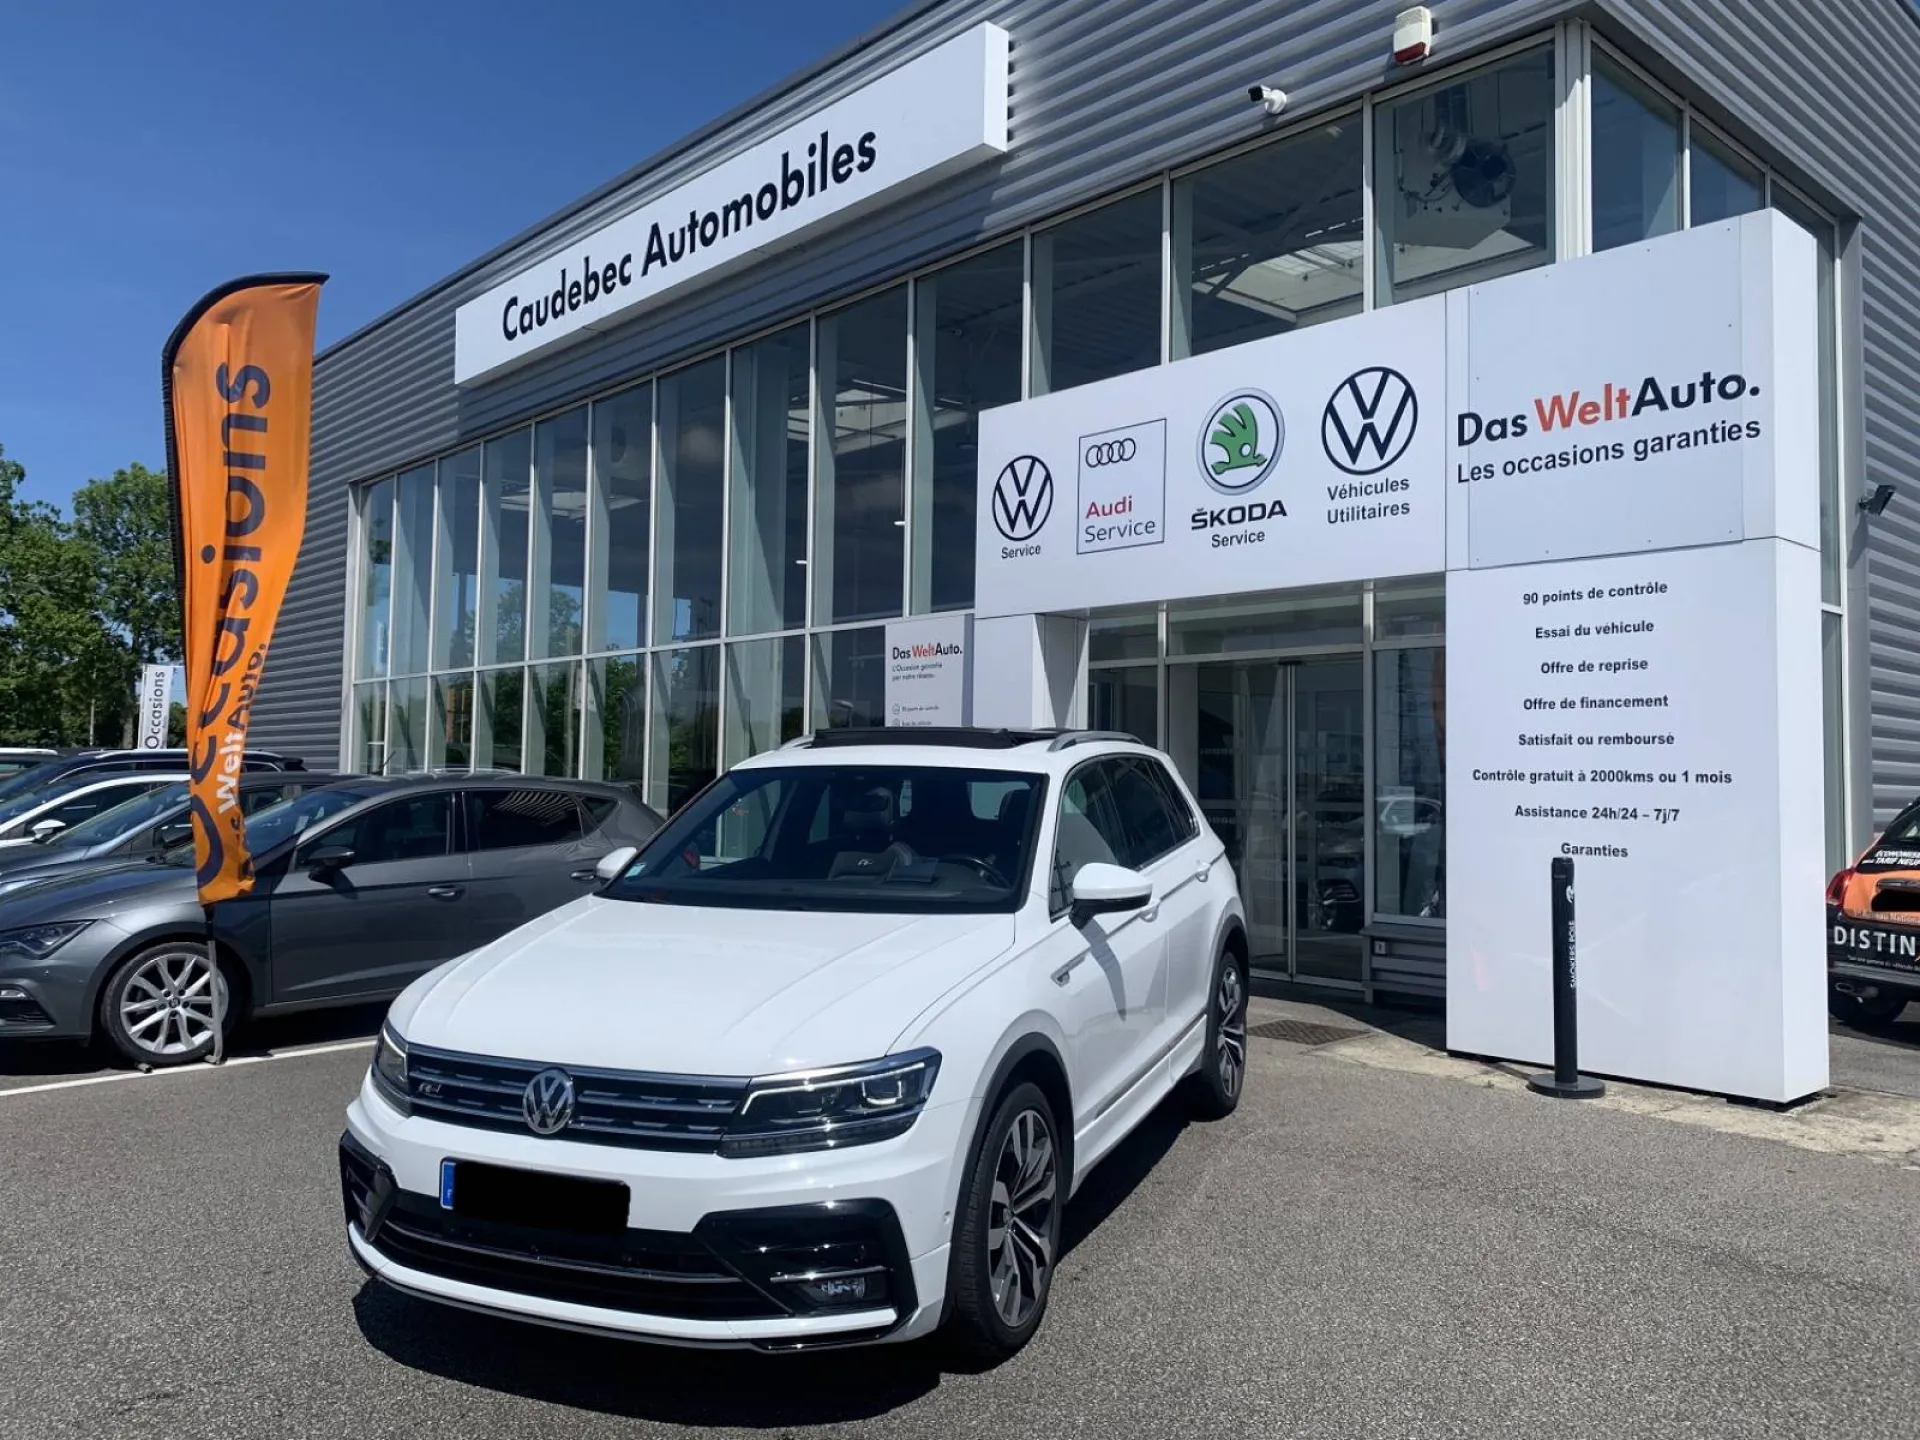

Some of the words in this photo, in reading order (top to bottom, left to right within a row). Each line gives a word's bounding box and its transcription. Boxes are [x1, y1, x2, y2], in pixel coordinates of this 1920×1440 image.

[502, 253, 632, 341] Caudebec
[641, 130, 877, 278] Automobiles
[1457, 411, 1528, 447] Das
[1533, 371, 1761, 433] WeltAuto.
[1457, 462, 1495, 484] Les
[1502, 442, 1625, 477] occasions
[1633, 419, 1761, 461] garanties
[1327, 477, 1410, 501] Véhicules
[1085, 495, 1133, 519] Audi
[1191, 499, 1288, 531] ŠKODA
[1327, 502, 1411, 524] Utilitaires
[1085, 519, 1156, 544] Service
[1211, 529, 1266, 549] Service
[1001, 544, 1042, 560] Service
[1523, 592, 1539, 605] 90
[1542, 589, 1584, 606] points
[1587, 587, 1604, 600] de
[1608, 581, 1669, 597] contrôle
[1535, 625, 1570, 639] Essai
[1574, 624, 1591, 637] du
[1595, 620, 1655, 636] véhicule
[892, 646, 912, 660] Das
[1540, 661, 1574, 674] Offre
[1578, 660, 1594, 673] de
[1599, 658, 1649, 674] reprise
[144, 671, 165, 749] Occasions
[1523, 697, 1556, 710] Offre
[1560, 697, 1577, 709] de
[1580, 694, 1669, 709] financement
[1518, 733, 1573, 746] Satisfait
[1577, 735, 1594, 746] ou
[1598, 732, 1675, 746] remboursé
[1472, 768, 1526, 782] Contrôle
[1529, 769, 1574, 784] gratuit
[1577, 769, 1586, 782] à
[1590, 769, 1654, 783] 2000kms
[1658, 771, 1676, 783] ou
[1681, 770, 1689, 783] 1
[1695, 769, 1733, 784] mois
[1515, 804, 1588, 819] Assistance
[1591, 806, 1638, 820] 24h/24
[1653, 807, 1680, 824] 7j/7
[1560, 842, 1629, 858] Garanties
[1834, 925, 1920, 960] DISTIN
